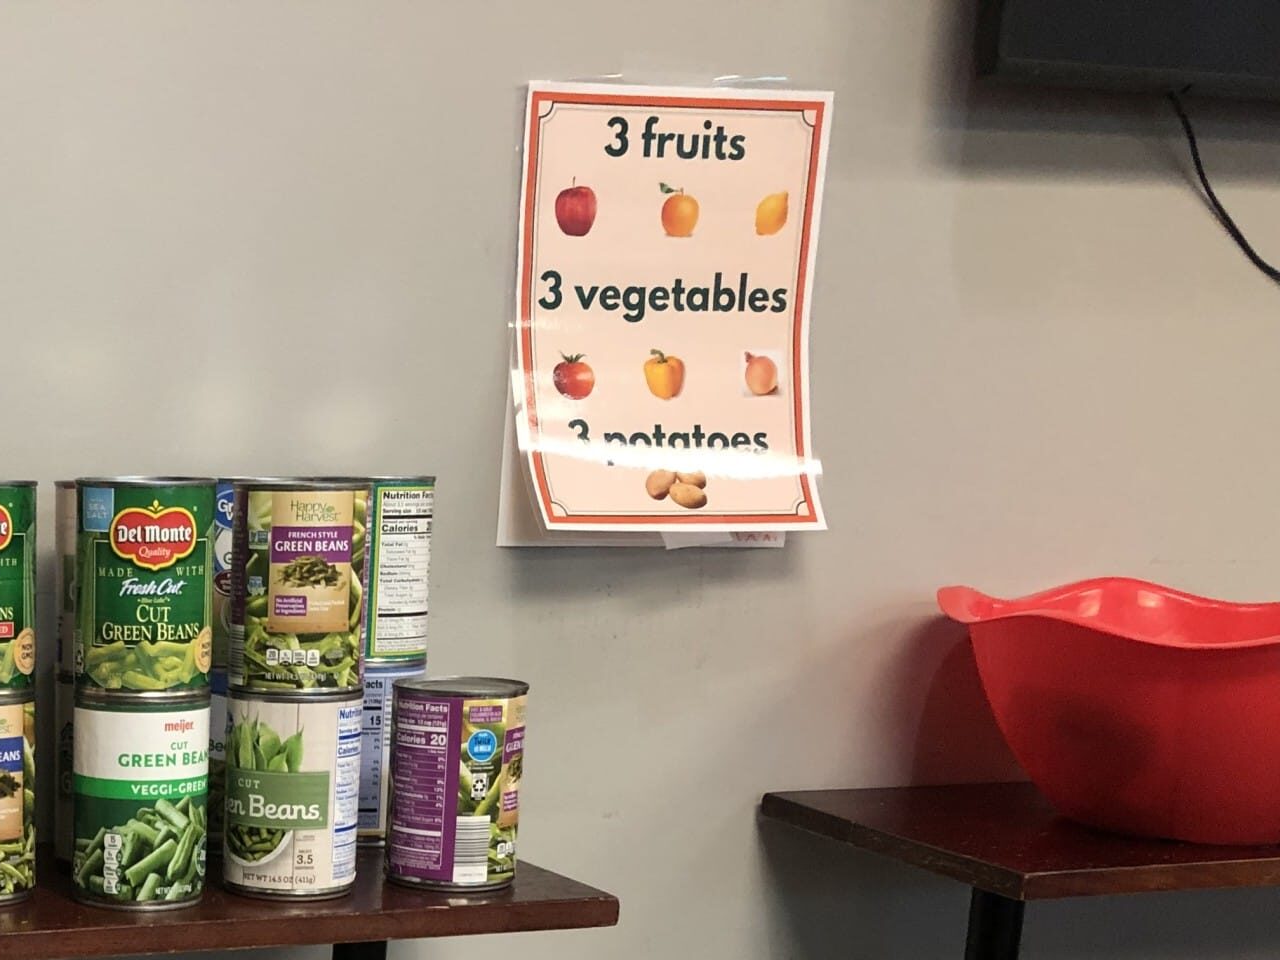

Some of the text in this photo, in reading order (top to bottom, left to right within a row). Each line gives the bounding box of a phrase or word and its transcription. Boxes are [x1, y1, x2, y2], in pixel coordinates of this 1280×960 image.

[604, 116, 747, 162] 3 fruits
[538, 270, 788, 323] 3 vegetables
[568, 418, 770, 458] 3 potatoes
[383, 491, 421, 500] Nutrition
[290, 500, 327, 512] Happy
[295, 511, 338, 522] Harvest
[117, 524, 192, 543] Del Monte
[287, 530, 338, 539] FRENCH STYLE
[381, 524, 418, 533] Calories
[138, 546, 171, 558] Quality
[274, 540, 349, 552] GREEN BEANS
[98, 565, 205, 577] MADE WITH
[119, 577, 156, 597] Fresh
[136, 605, 171, 623] CUT
[102, 622, 199, 641] GREEN BEANS
[164, 720, 194, 733] meijer
[170, 741, 188, 751] CUT
[118, 753, 177, 768] GREEN
[131, 782, 206, 795] VEGGI-GREEN
[238, 778, 261, 789] CUT
